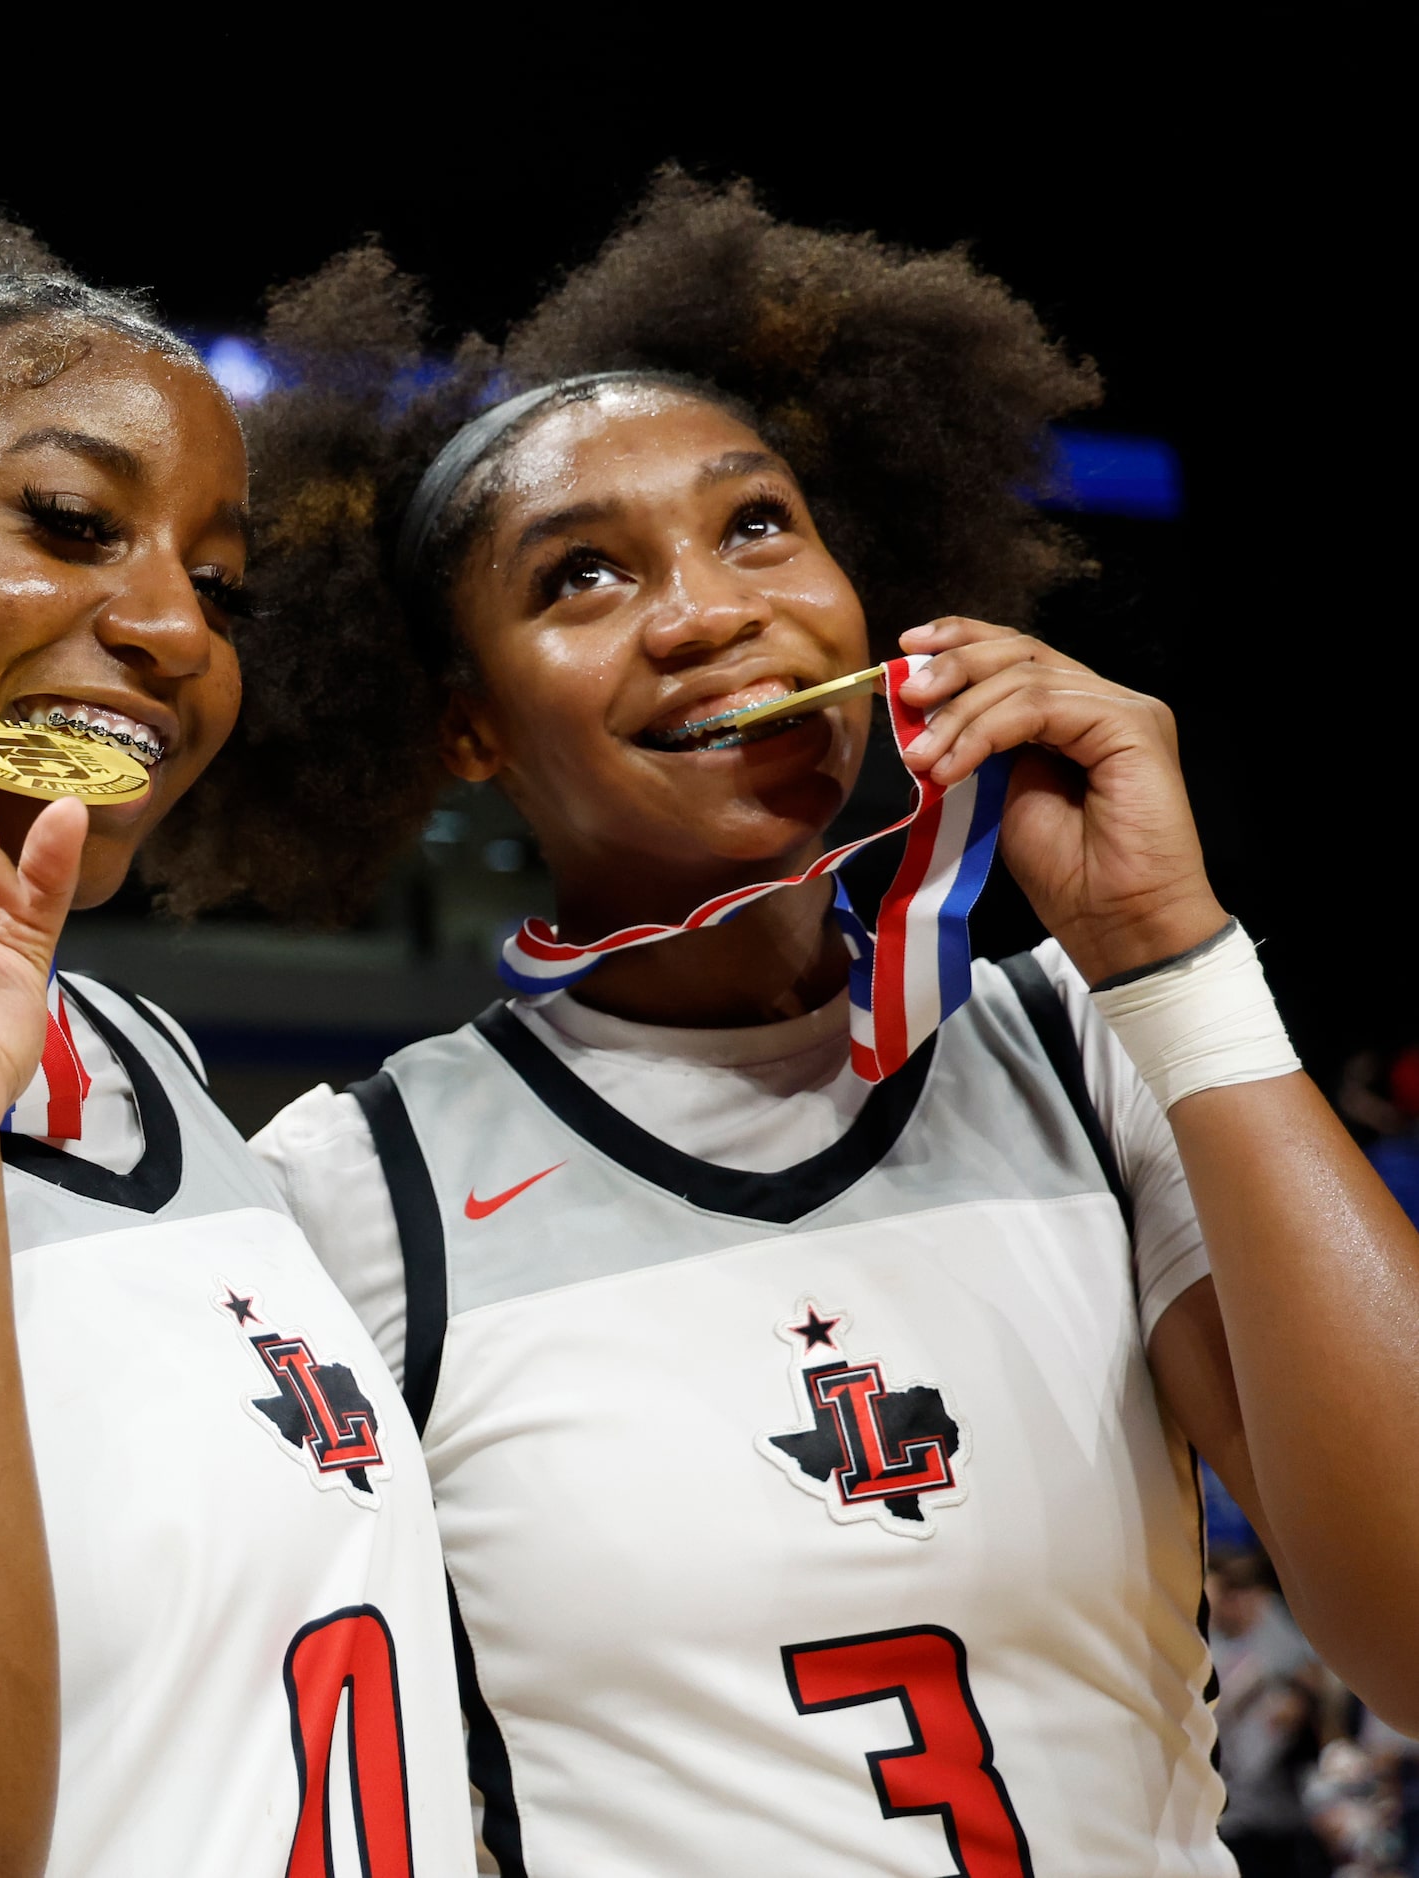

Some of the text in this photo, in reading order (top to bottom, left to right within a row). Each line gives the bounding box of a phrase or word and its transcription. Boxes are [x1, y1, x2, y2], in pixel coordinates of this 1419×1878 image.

[258, 1337, 384, 1473] L
[808, 1362, 956, 1506] L
[780, 1624, 1035, 1878] 3
